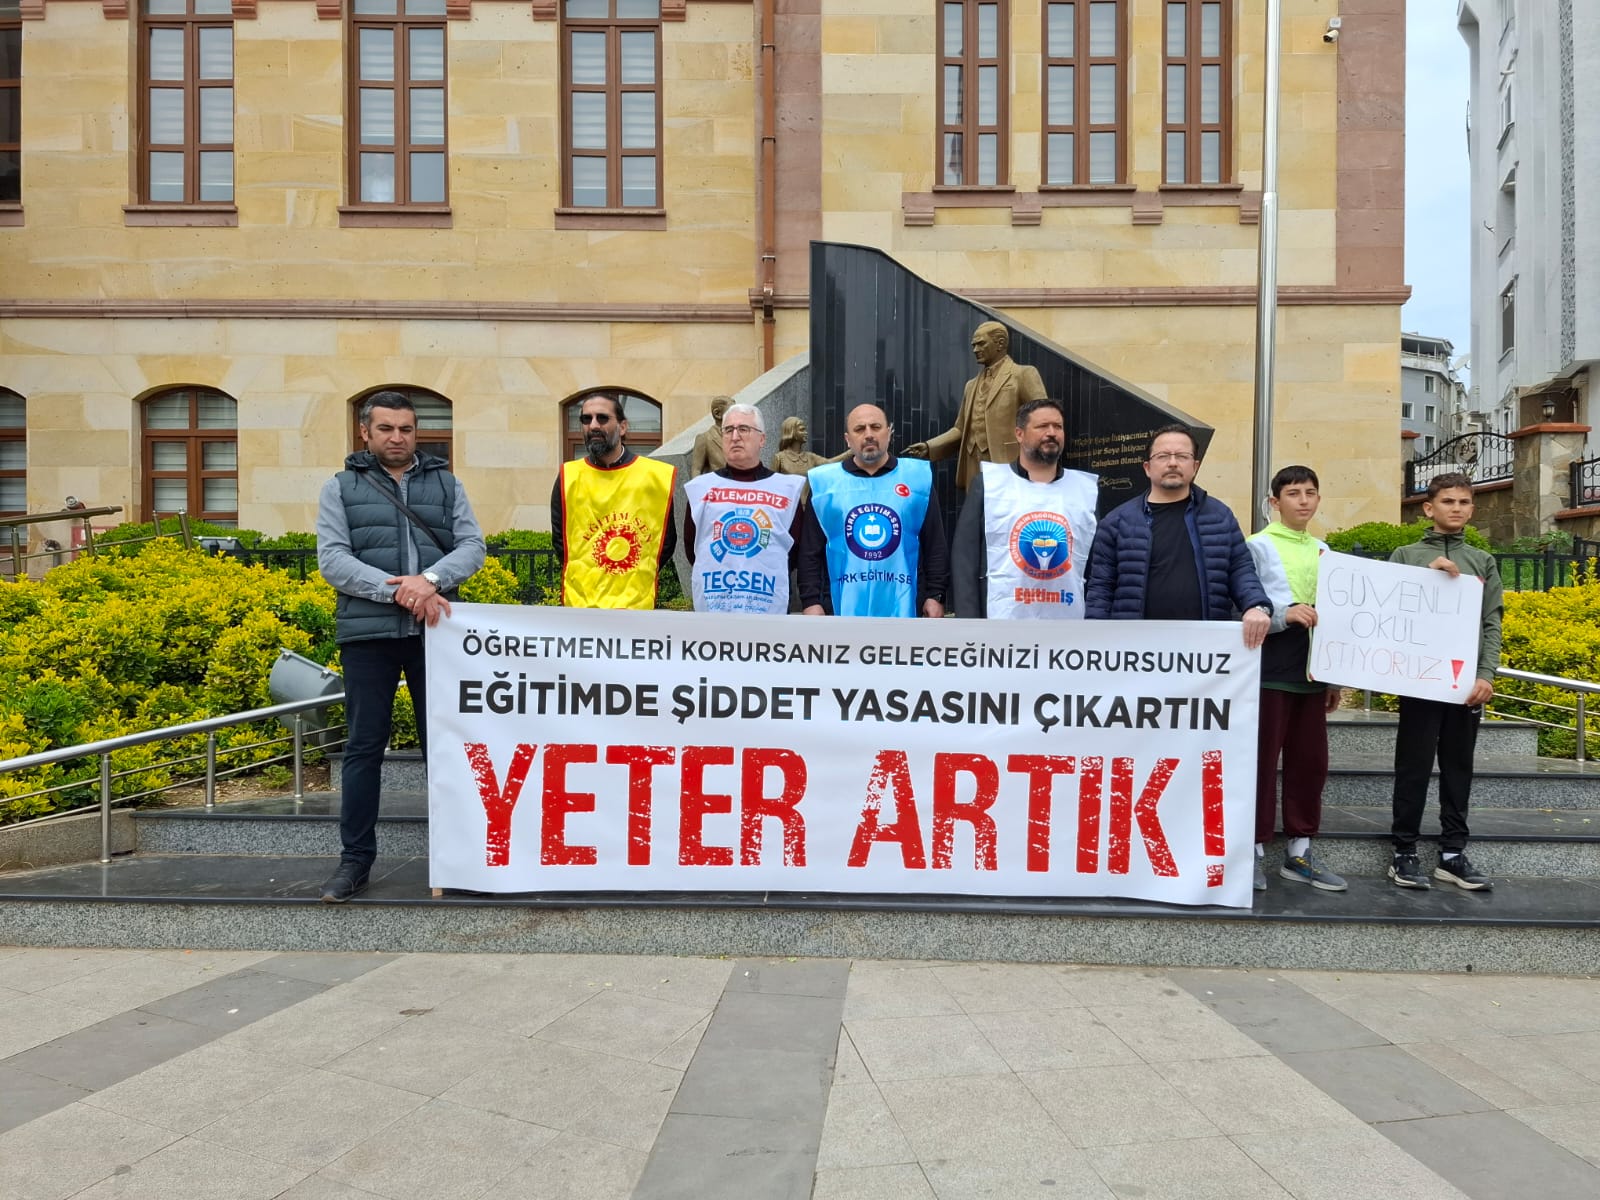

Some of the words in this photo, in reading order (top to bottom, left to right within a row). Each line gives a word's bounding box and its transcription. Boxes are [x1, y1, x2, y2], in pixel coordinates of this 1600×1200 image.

[708, 490, 783, 507] EYLEMDEYİZ
[864, 551, 884, 559] 1992
[1350, 611, 1428, 646] OKUL
[463, 630, 670, 659] ÖĞRETMENLERİ
[683, 641, 849, 663] KORURSANIZ
[860, 643, 1038, 668] GELECEĞİNİZİ
[1050, 650, 1230, 674] KORURSUNUZ
[460, 672, 658, 716] EĞİTİMDE
[672, 678, 819, 724] ŞİDDET
[832, 689, 1019, 724] YASASINI
[1034, 694, 1230, 733] ÇIKARTIN
[465, 744, 807, 866] YETER
